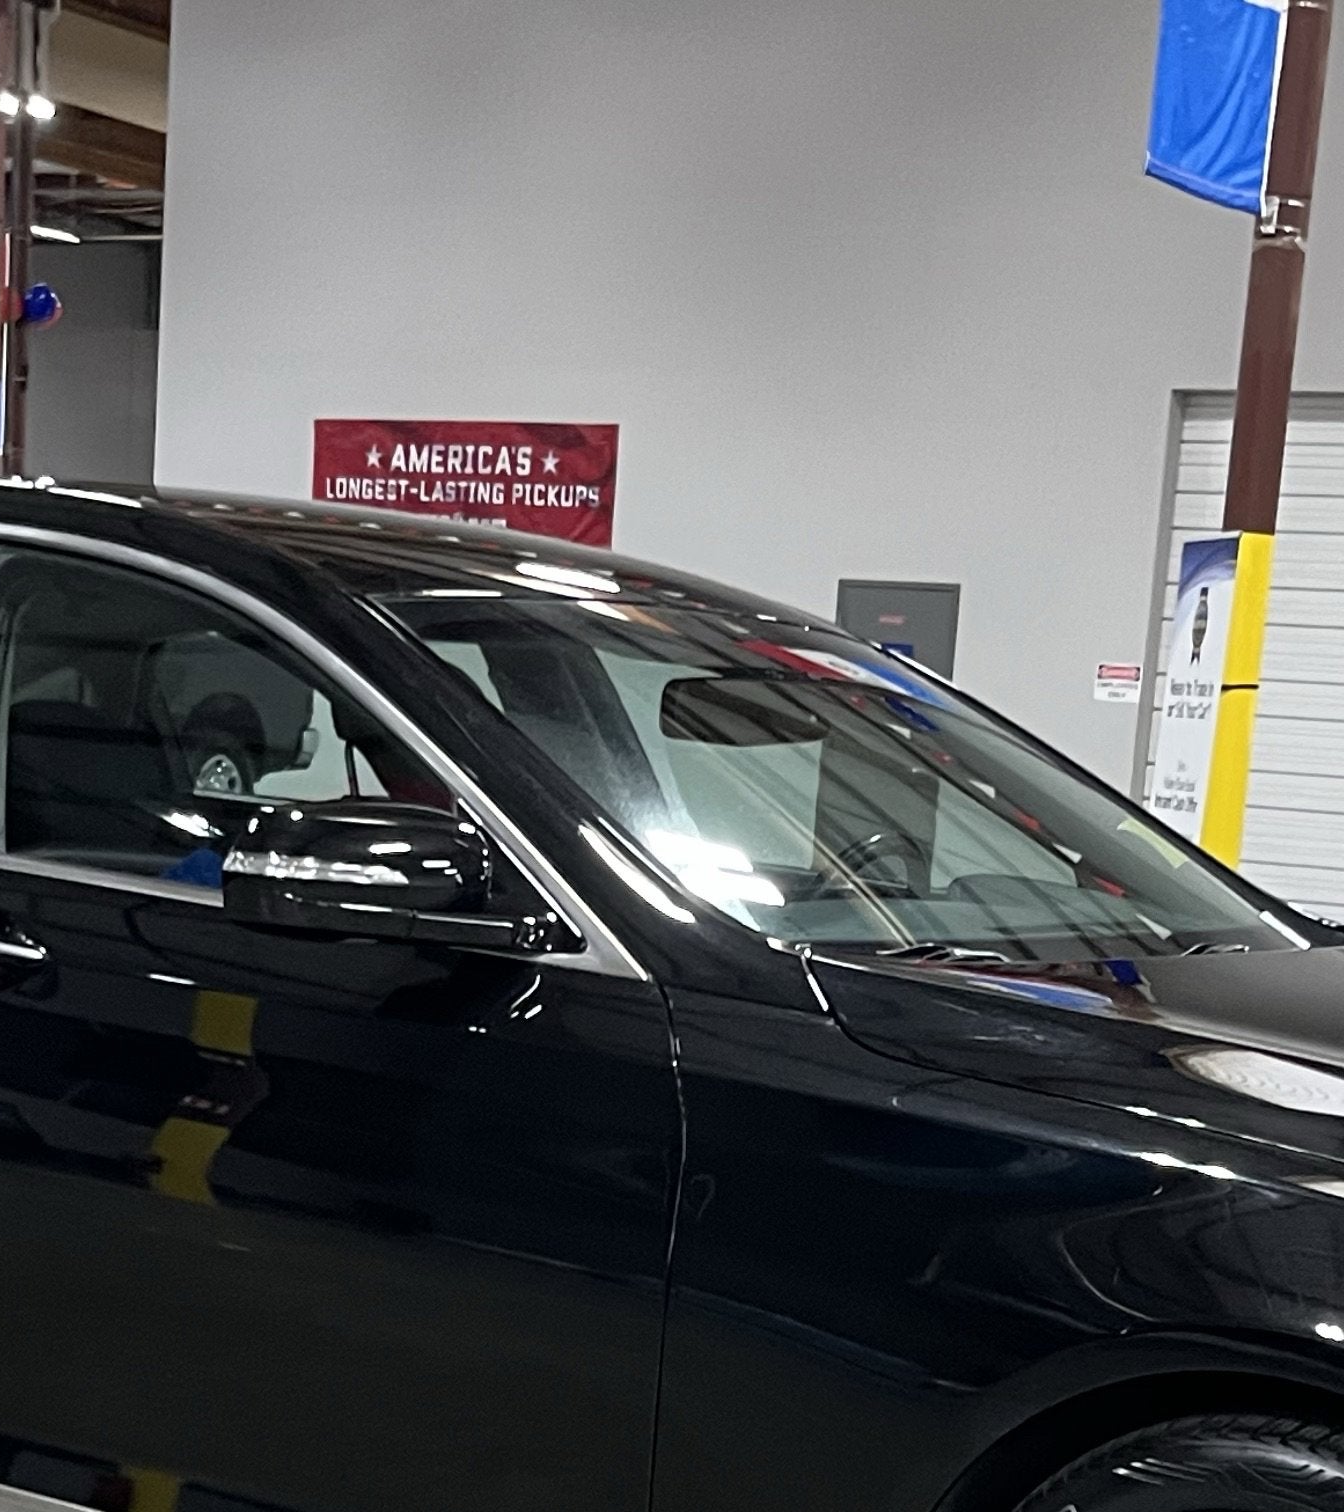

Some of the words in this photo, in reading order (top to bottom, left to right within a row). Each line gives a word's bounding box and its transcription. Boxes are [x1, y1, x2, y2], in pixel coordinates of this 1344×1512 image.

[390, 444, 532, 476] AMERICA'S
[325, 477, 505, 505] LONGEST-LASTING
[511, 484, 600, 508] PICKUPS
